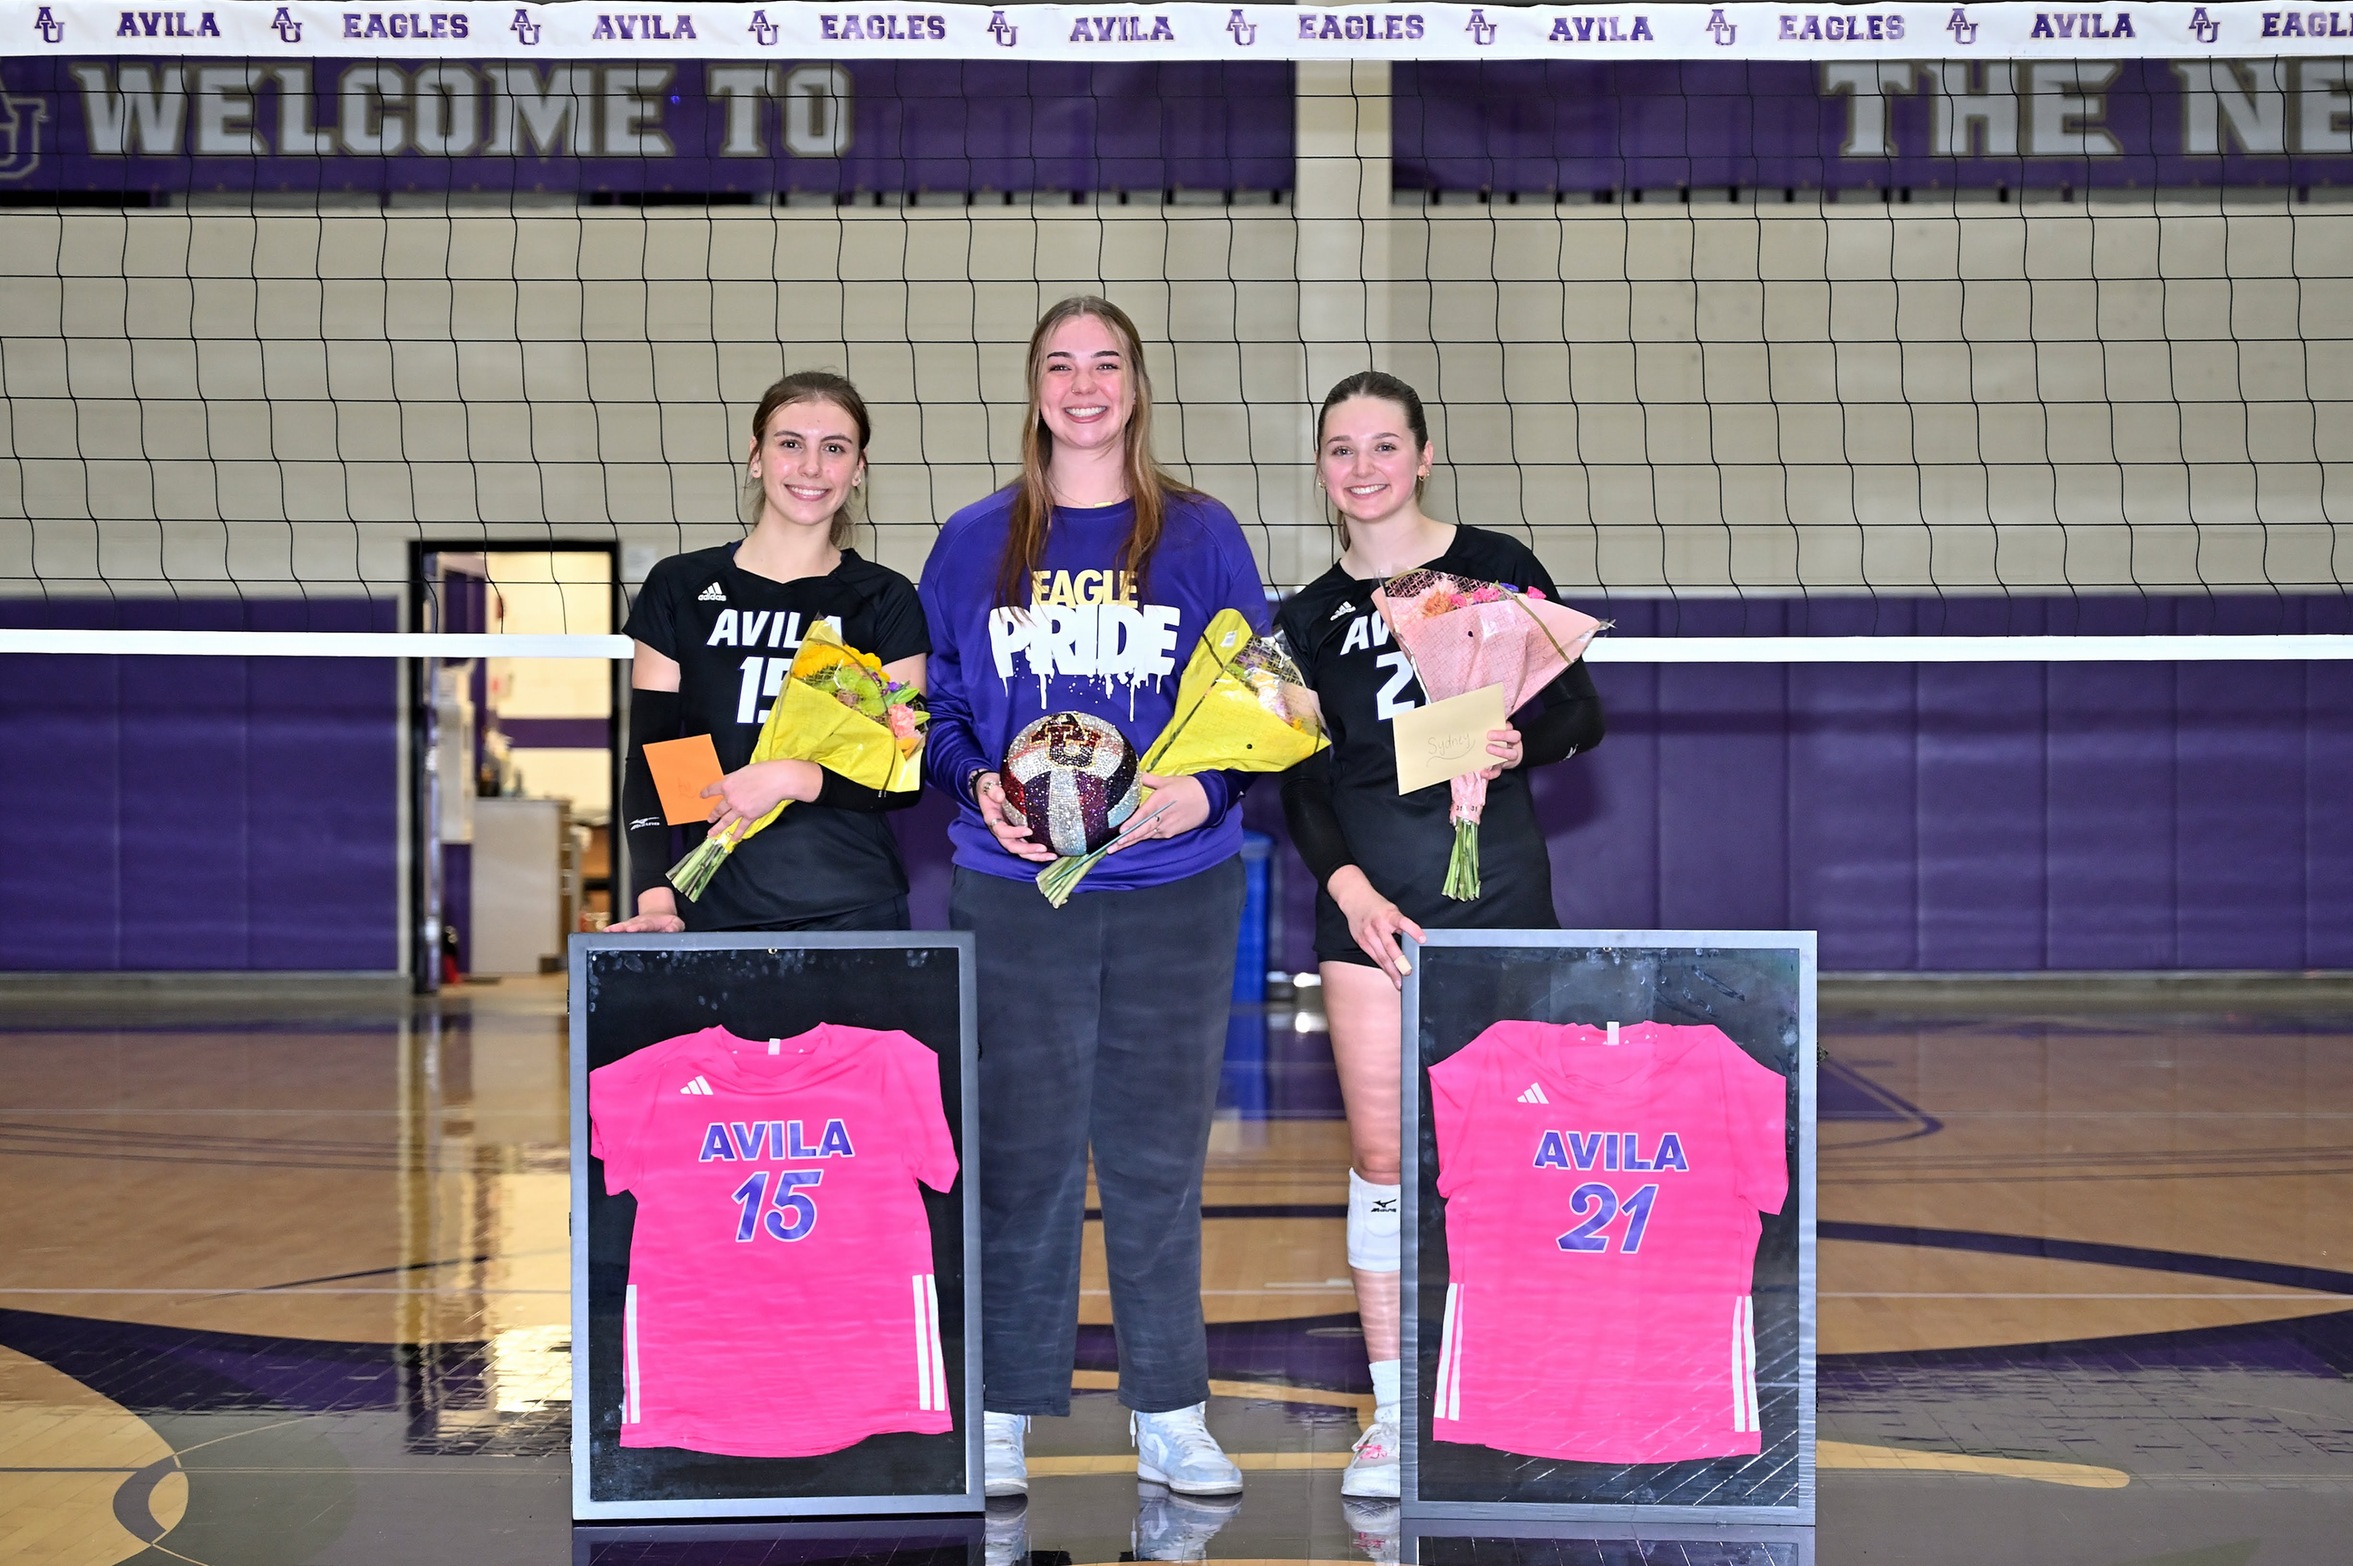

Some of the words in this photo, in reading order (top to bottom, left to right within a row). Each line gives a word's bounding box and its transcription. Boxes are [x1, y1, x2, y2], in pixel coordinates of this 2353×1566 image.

[34, 7, 65, 44] AU
[117, 11, 221, 38] AVILA
[270, 7, 303, 44] AU
[342, 13, 470, 39] EAGLES
[509, 8, 541, 46] AU
[591, 14, 697, 40] AVILA
[746, 9, 779, 47] AU
[820, 14, 946, 41] EAGLES
[986, 10, 1018, 48] AU
[1069, 15, 1175, 42] AVILA
[1224, 8, 1256, 47] AU
[1298, 14, 1425, 40] EAGLES
[1463, 8, 1496, 46] AU
[1549, 15, 1654, 42] AVILA
[1704, 8, 1737, 47] AU
[1778, 15, 1905, 41] EAGLES
[1945, 7, 1978, 46] AU
[2030, 12, 2136, 40] AVILA
[2186, 7, 2220, 44] AU
[2261, 12, 2353, 38] EAGL
[69, 62, 674, 157] WELCOME
[706, 62, 853, 157] TO
[1820, 60, 2124, 158] THE
[697, 592, 727, 601] adidas
[1031, 569, 1139, 609] EAGLE
[988, 604, 1181, 684] PRIDE
[1376, 650, 1416, 721] 2
[1427, 732, 1471, 756] Sydney
[699, 1118, 855, 1162] AVILA
[1534, 1130, 1689, 1172] AVILA
[731, 1168, 824, 1243] 15
[1556, 1182, 1659, 1255] 21
